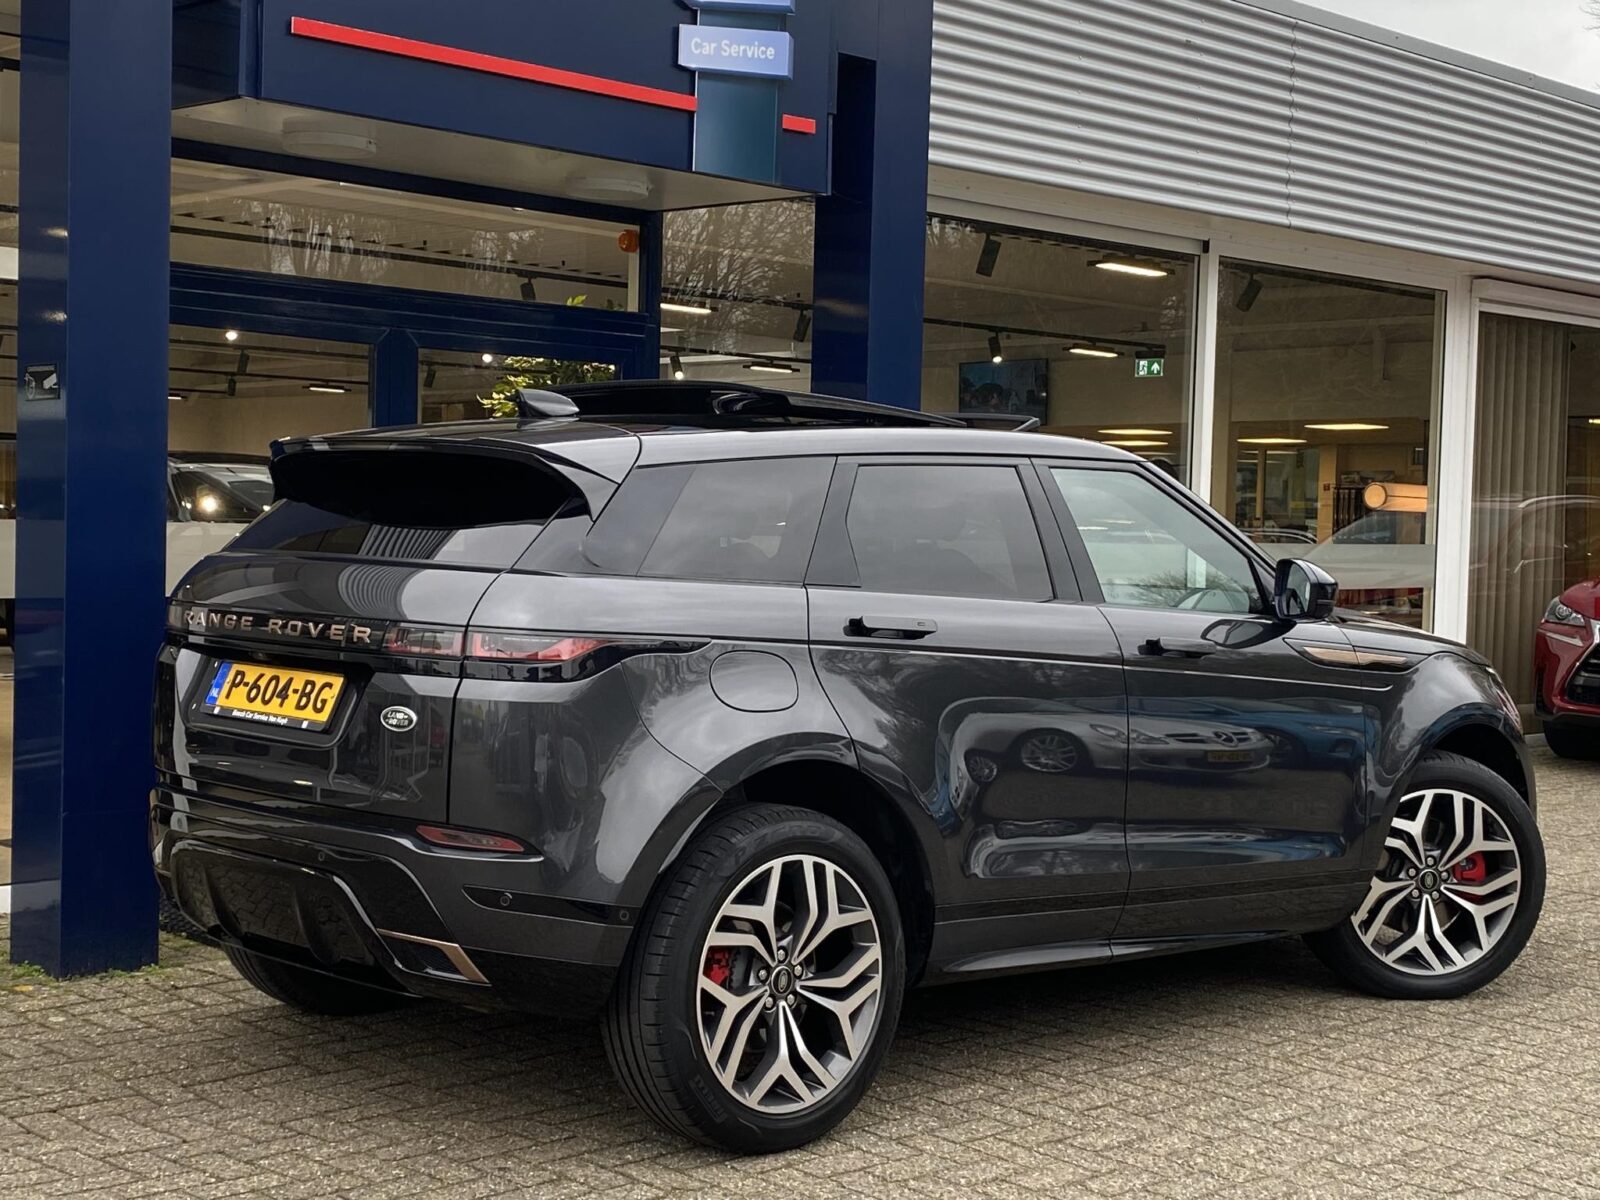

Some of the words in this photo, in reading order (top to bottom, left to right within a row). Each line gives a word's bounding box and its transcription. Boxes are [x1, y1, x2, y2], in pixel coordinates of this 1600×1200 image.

[690, 37, 717, 56] Car
[721, 39, 776, 60] Service
[183, 609, 254, 632] RANGE
[268, 618, 372, 645] ROVER
[224, 669, 334, 714] P-604-BG
